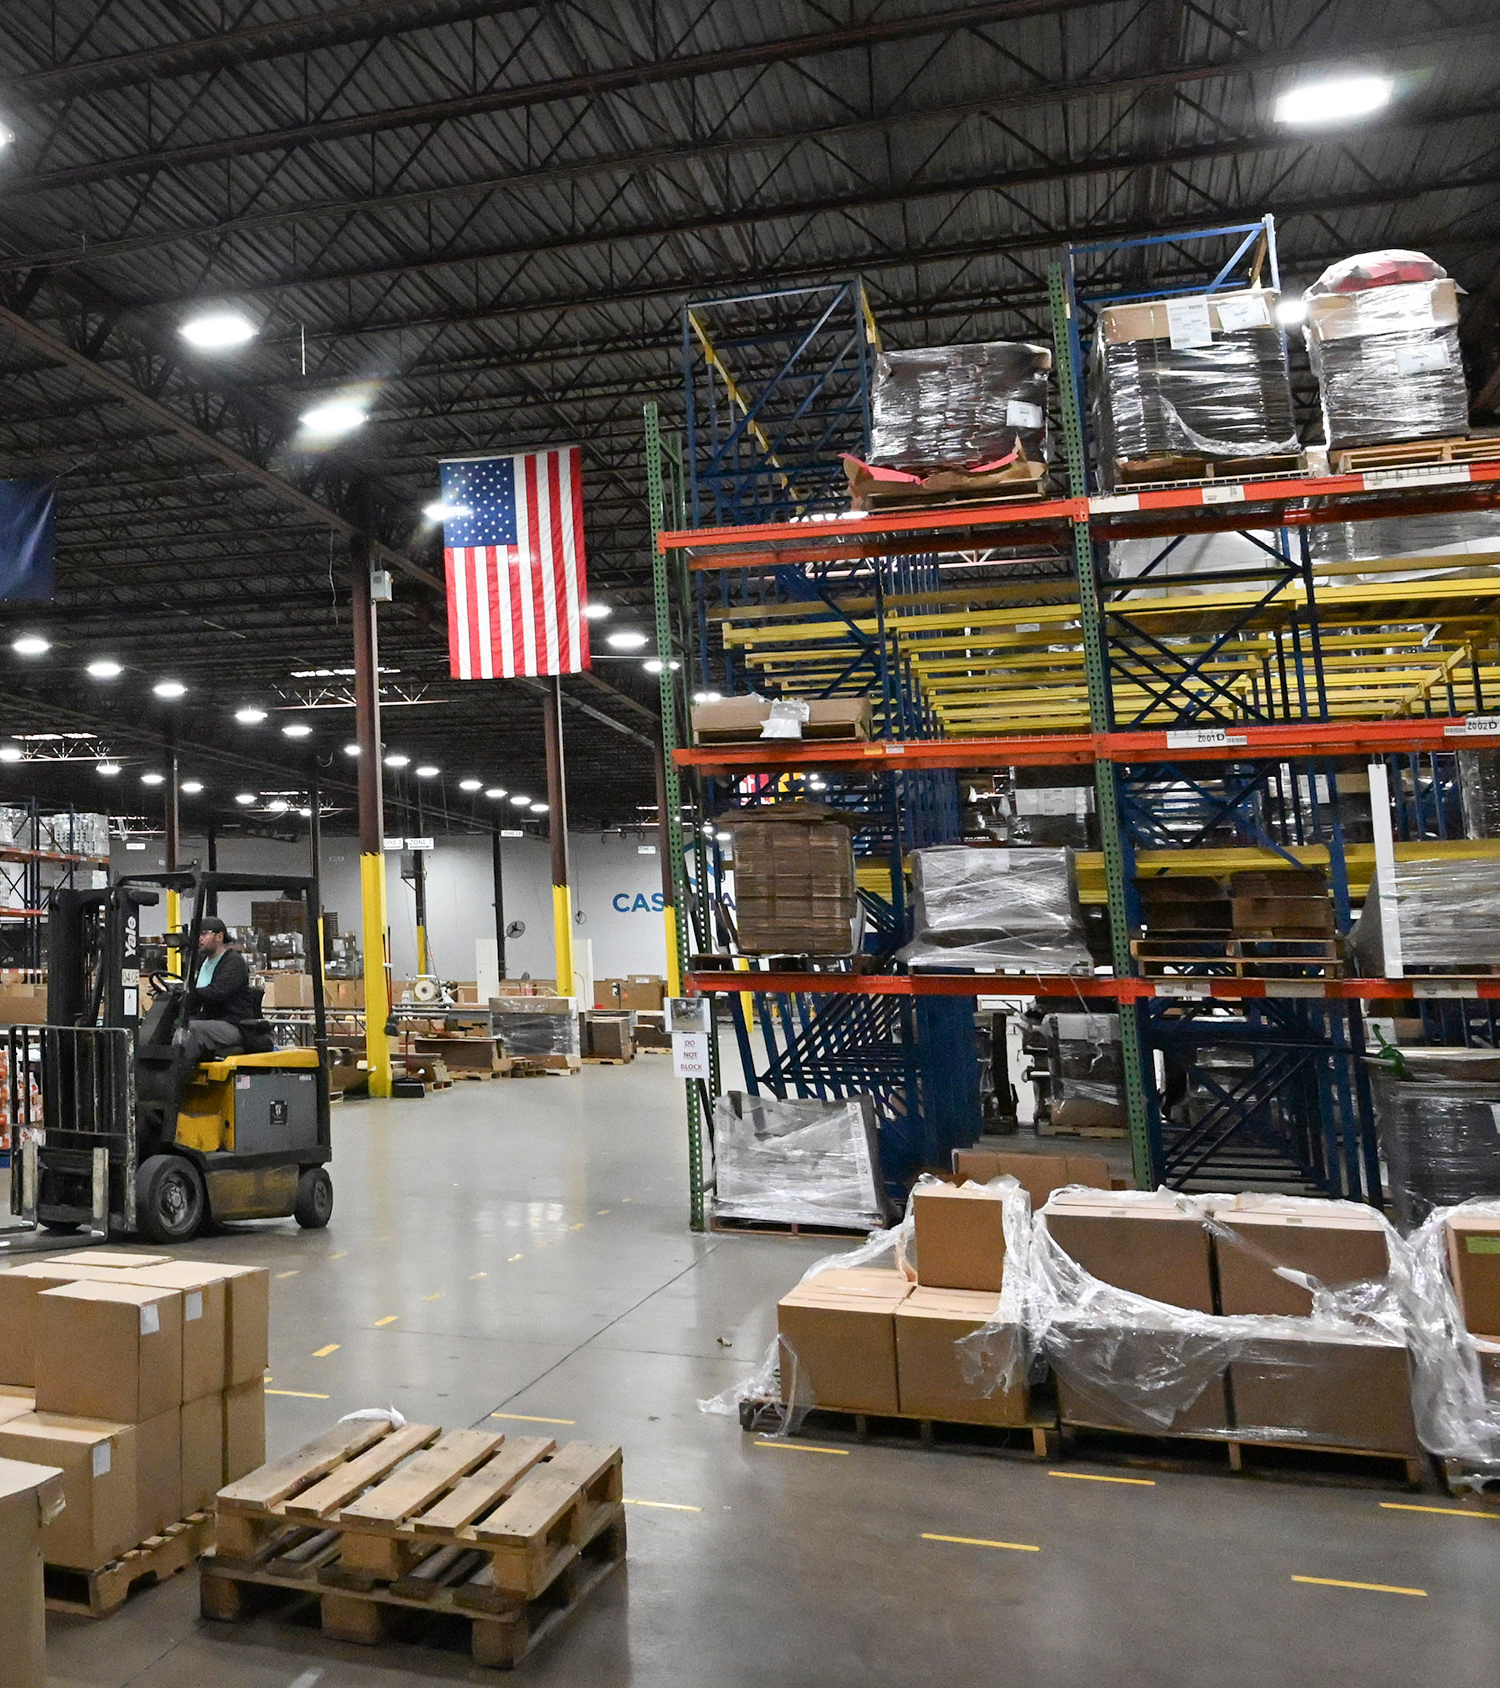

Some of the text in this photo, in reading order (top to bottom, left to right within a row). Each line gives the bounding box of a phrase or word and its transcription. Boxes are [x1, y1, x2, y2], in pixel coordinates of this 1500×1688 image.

[612, 893, 664, 913] CAS
[125, 915, 137, 958] Yale
[680, 1063, 702, 1071] BLOCK
